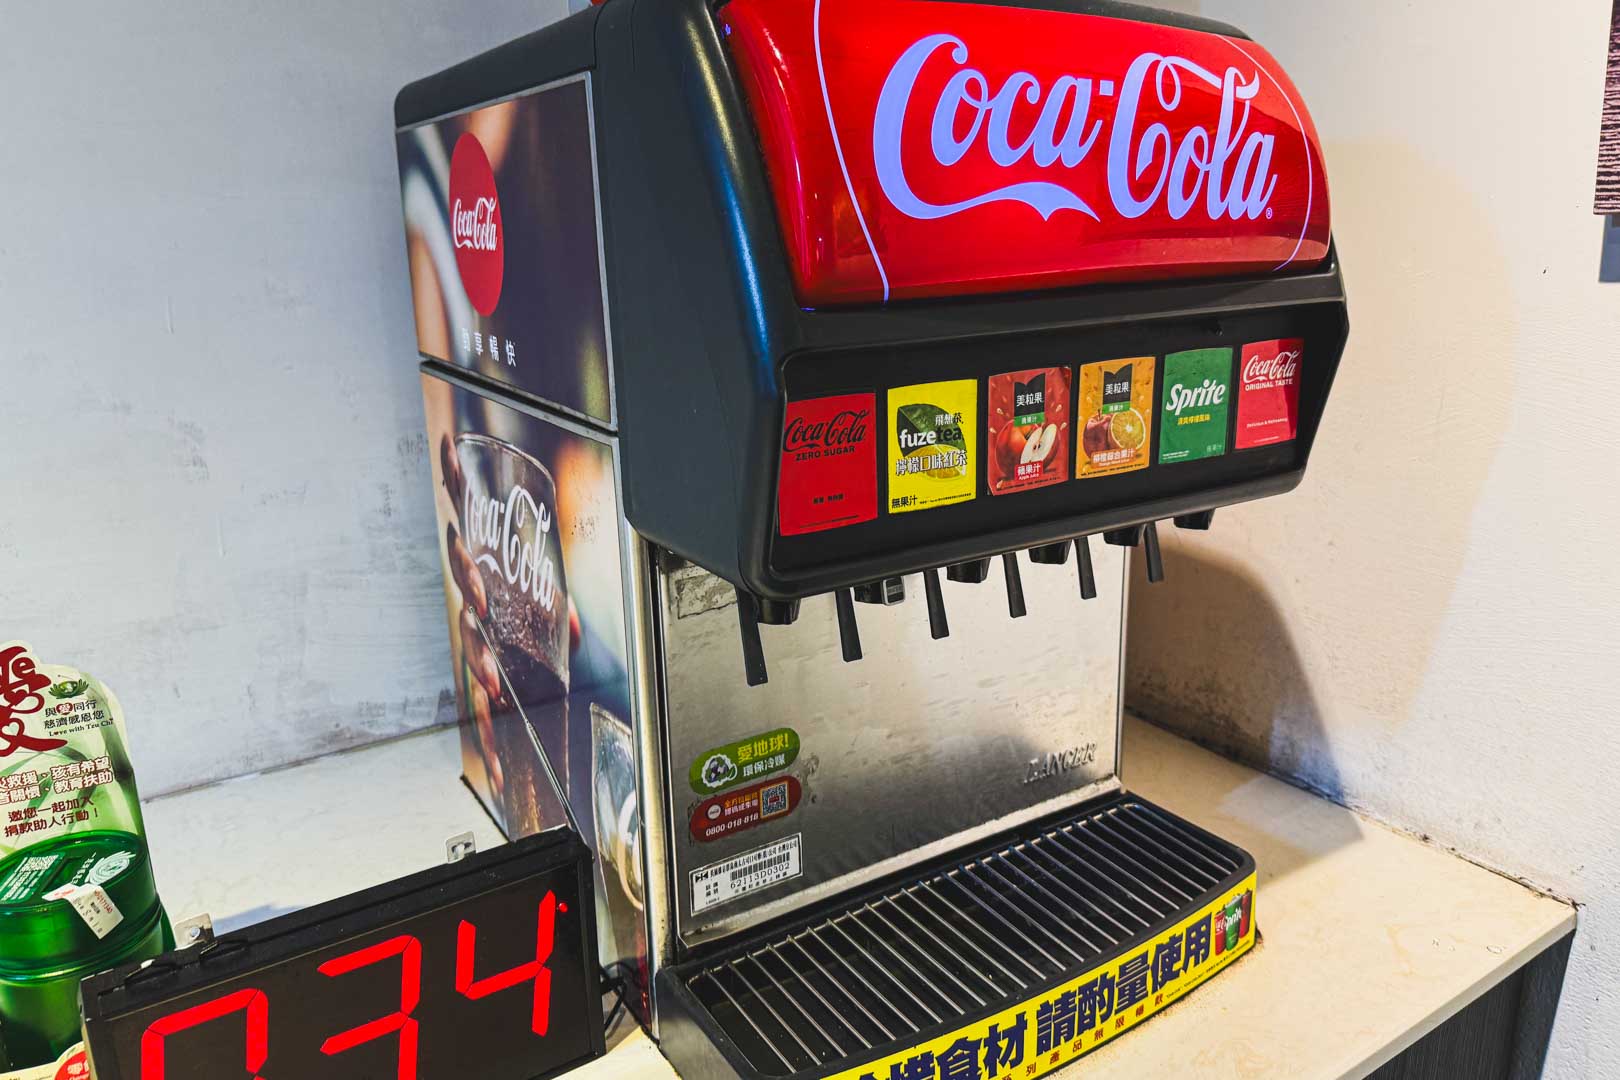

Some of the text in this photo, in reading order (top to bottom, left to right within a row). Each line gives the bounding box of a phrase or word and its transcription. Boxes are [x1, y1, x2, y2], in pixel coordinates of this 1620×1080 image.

[873, 34, 1278, 222] Coca-Cola
[453, 197, 497, 251] Coca-Cola
[1243, 350, 1300, 384] Coca-Cola
[1105, 381, 1130, 395] 美粒果
[1165, 379, 1226, 416] Sprite
[1245, 378, 1293, 391] ORIGINAL TASTE
[1016, 391, 1043, 407] 美粒果
[785, 409, 870, 453] Coca-Cola
[796, 446, 855, 462] ZERO SUGAR
[896, 449, 967, 476] 檸檬口味紅茶
[1017, 463, 1041, 476] 蘋果汁
[891, 495, 918, 509] 無果汁
[44, 710, 104, 729] 慈濟感恩您
[743, 753, 785, 777] 環保冷媒
[8, 796, 94, 822] 邀您一起加入
[730, 862, 791, 889] 62113D0302
[859, 1011, 1028, 1080] 惜食材
[1036, 911, 1212, 1057] 請酌量使用
